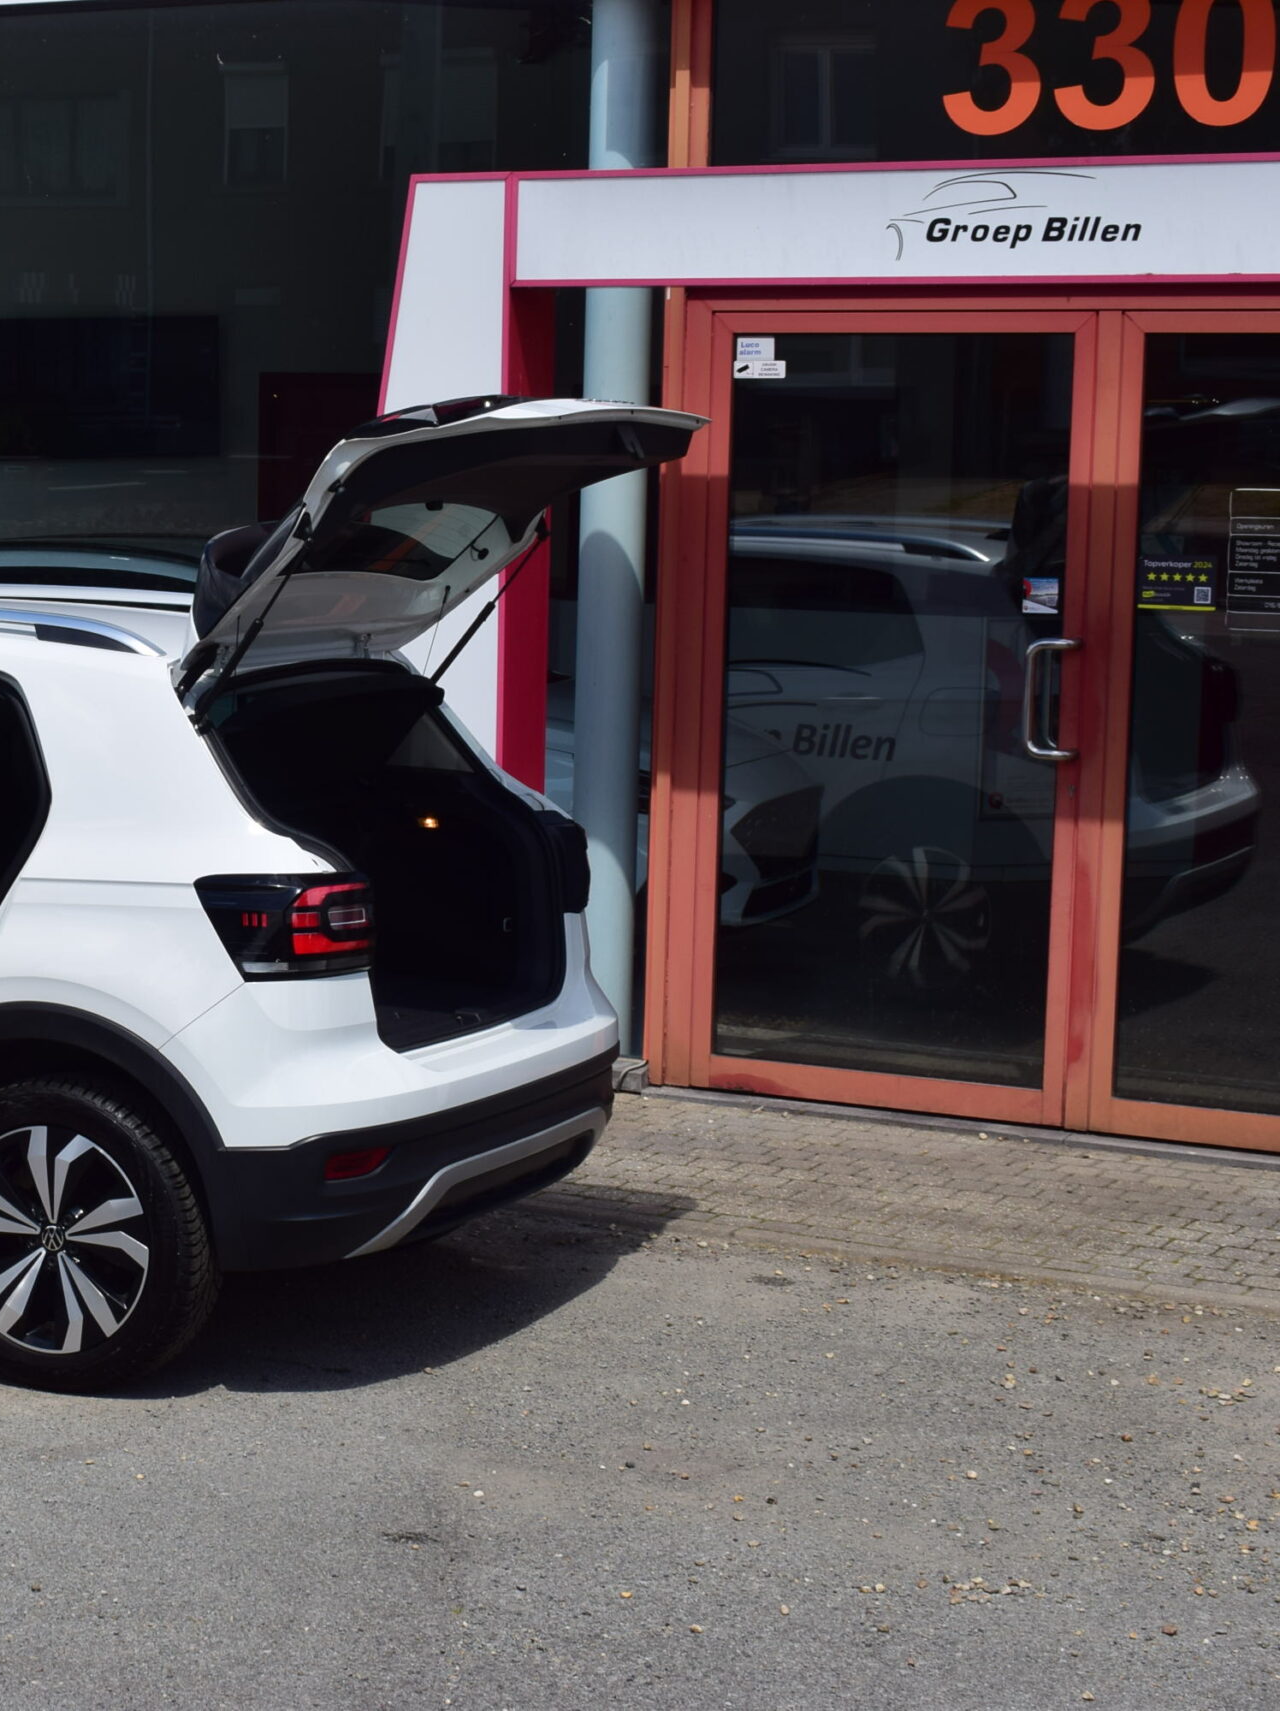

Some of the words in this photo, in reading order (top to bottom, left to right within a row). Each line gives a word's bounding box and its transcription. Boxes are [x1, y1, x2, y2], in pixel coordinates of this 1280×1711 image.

[943, 0, 1276, 136] 330
[926, 217, 1033, 249] Groep
[1041, 216, 1142, 242] Billen
[1143, 559, 1192, 569] Topverkoper
[1193, 560, 1213, 568] 2024
[792, 723, 897, 762] Billen
